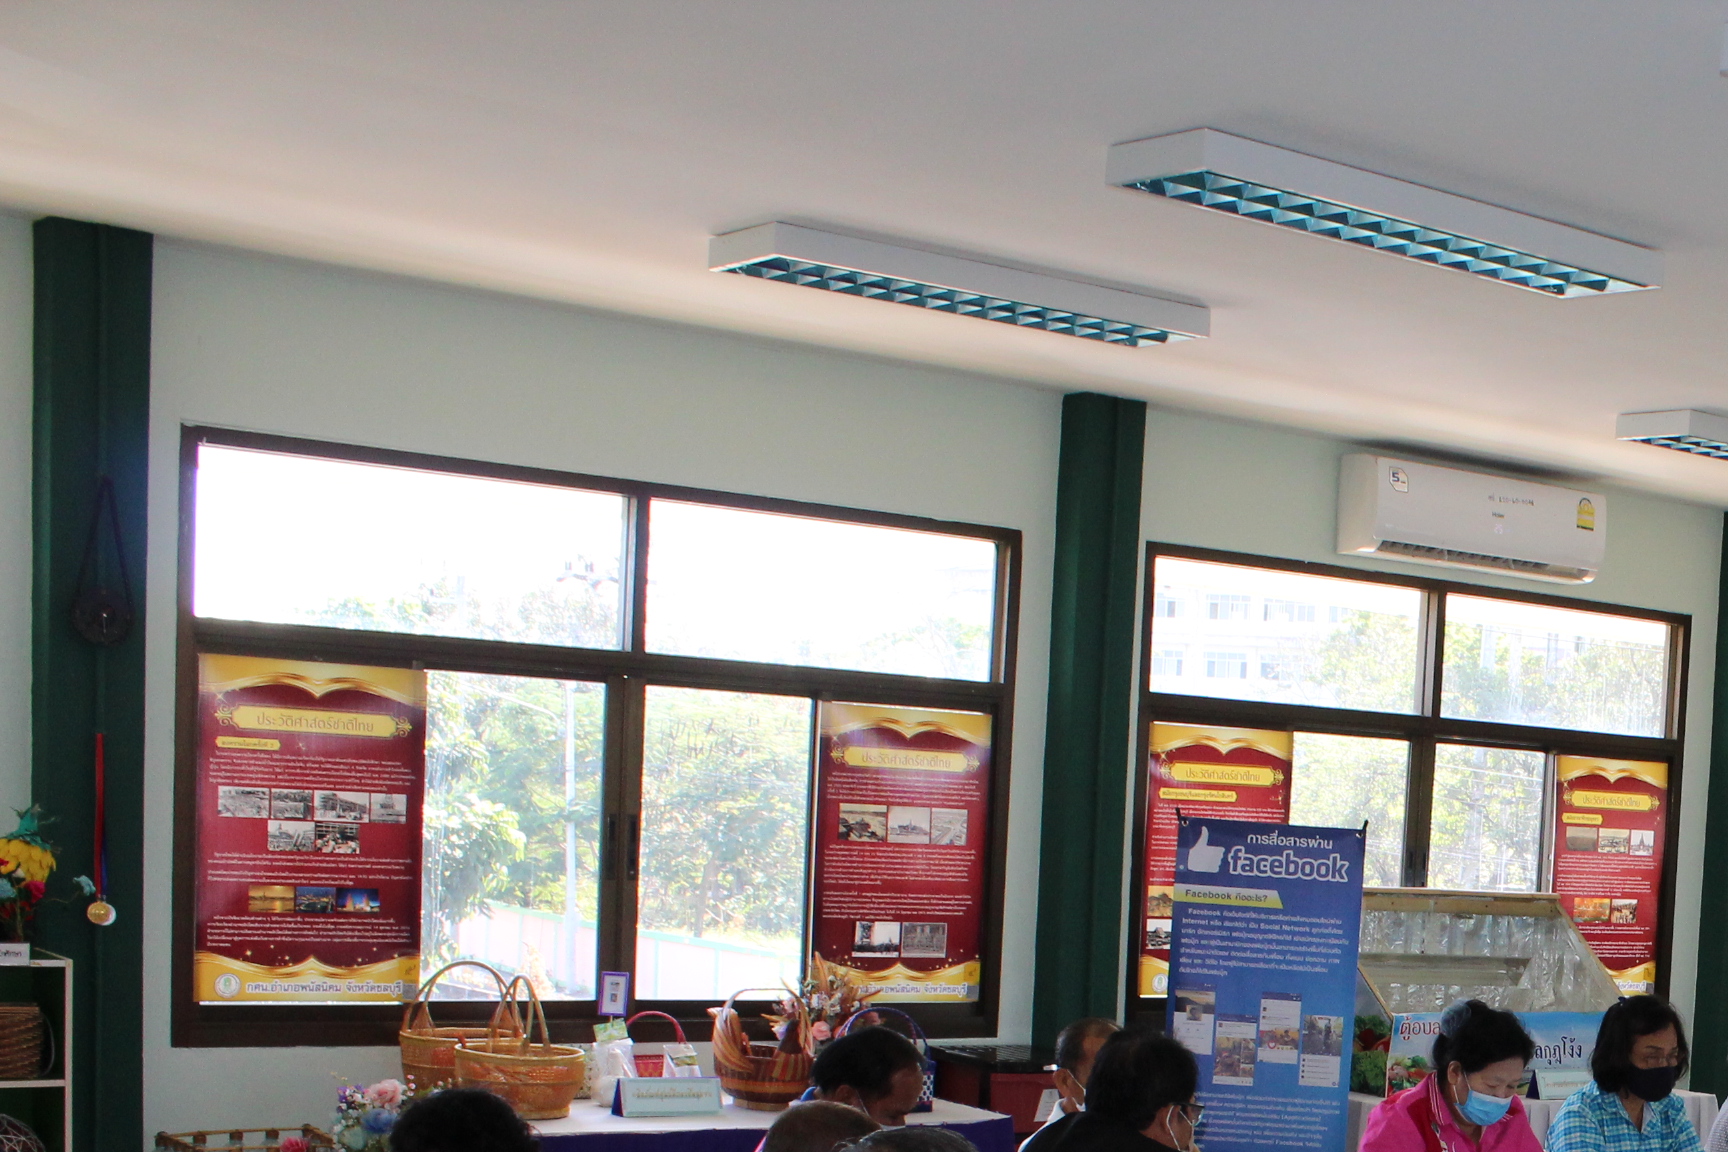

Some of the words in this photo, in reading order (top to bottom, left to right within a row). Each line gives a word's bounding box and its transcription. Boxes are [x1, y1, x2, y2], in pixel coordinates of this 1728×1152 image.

[1392, 471, 1400, 482] 5
[256, 710, 374, 732] ประวัติศาสตร์ชาติไทย
[861, 751, 951, 769] ประวัติศาสตร์ชาติไทย
[1185, 767, 1260, 782] ประวัติศาสตร์ชาติไทย
[1582, 795, 1641, 808] ประวัติศาสตร์ชาติไทย
[1247, 830, 1333, 850] การสื่อสารผ่าน
[1228, 846, 1349, 882] facebook
[1185, 889, 1232, 900] Facebook
[1283, 924, 1310, 932] Network
[246, 979, 342, 994] กศน.อำเภอพนัสนิคม
[345, 980, 402, 996] จังหวัดชลบุรี
